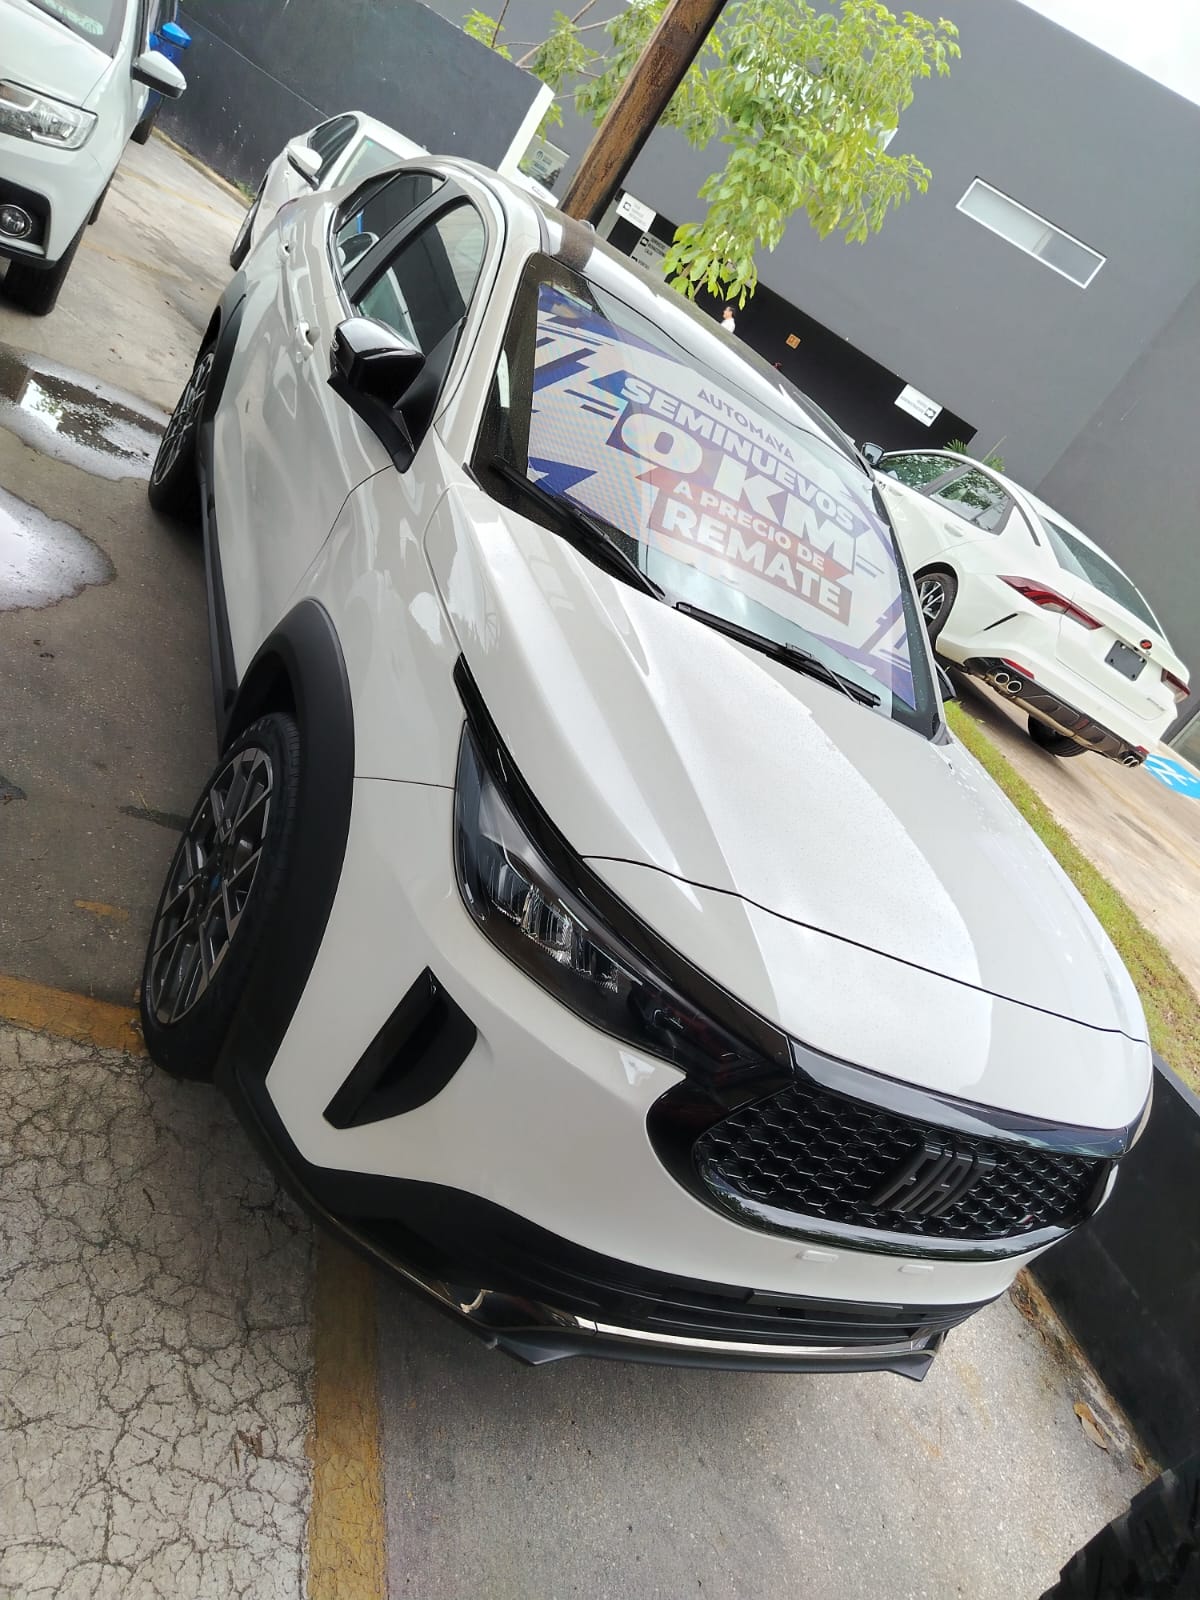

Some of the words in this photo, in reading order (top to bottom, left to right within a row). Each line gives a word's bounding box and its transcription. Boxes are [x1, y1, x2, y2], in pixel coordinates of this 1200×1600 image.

[621, 377, 853, 531] SEMINUEVOS
[697, 389, 795, 462] AUTOMAYA
[662, 498, 841, 615] REMATE
[673, 480, 693, 500] A
[700, 490, 792, 550] PRECIO
[797, 542, 825, 571] DE
[713, 454, 856, 573] KM
[871, 1143, 997, 1217] FIAT
